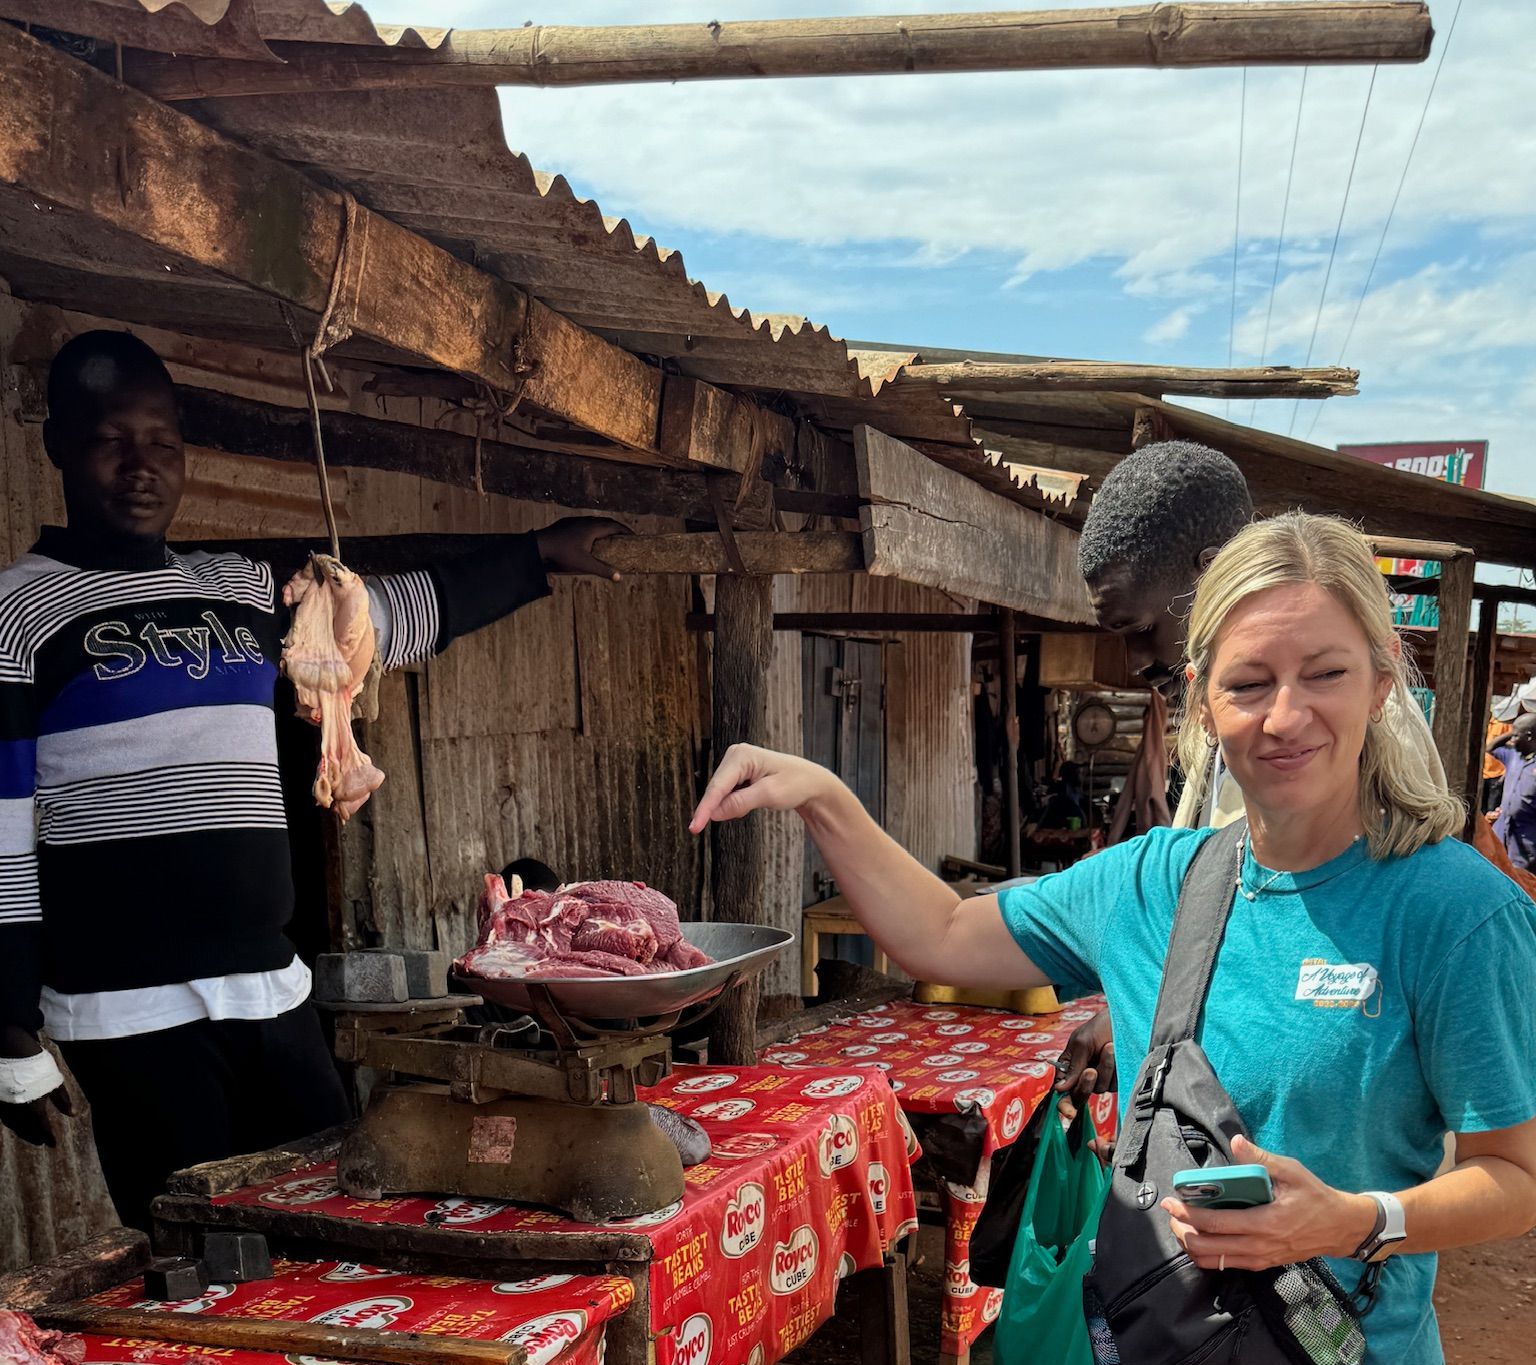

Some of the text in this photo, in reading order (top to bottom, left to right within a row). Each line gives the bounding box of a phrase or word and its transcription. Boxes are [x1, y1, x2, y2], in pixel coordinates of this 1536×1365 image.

[84, 610, 264, 681] Style
[664, 1232, 708, 1274] TASTIEST
[673, 1253, 704, 1289] BEANS
[776, 1241, 813, 1277] Royco
[785, 1268, 808, 1288] CUBE
[778, 1302, 822, 1339] TASTIEST
